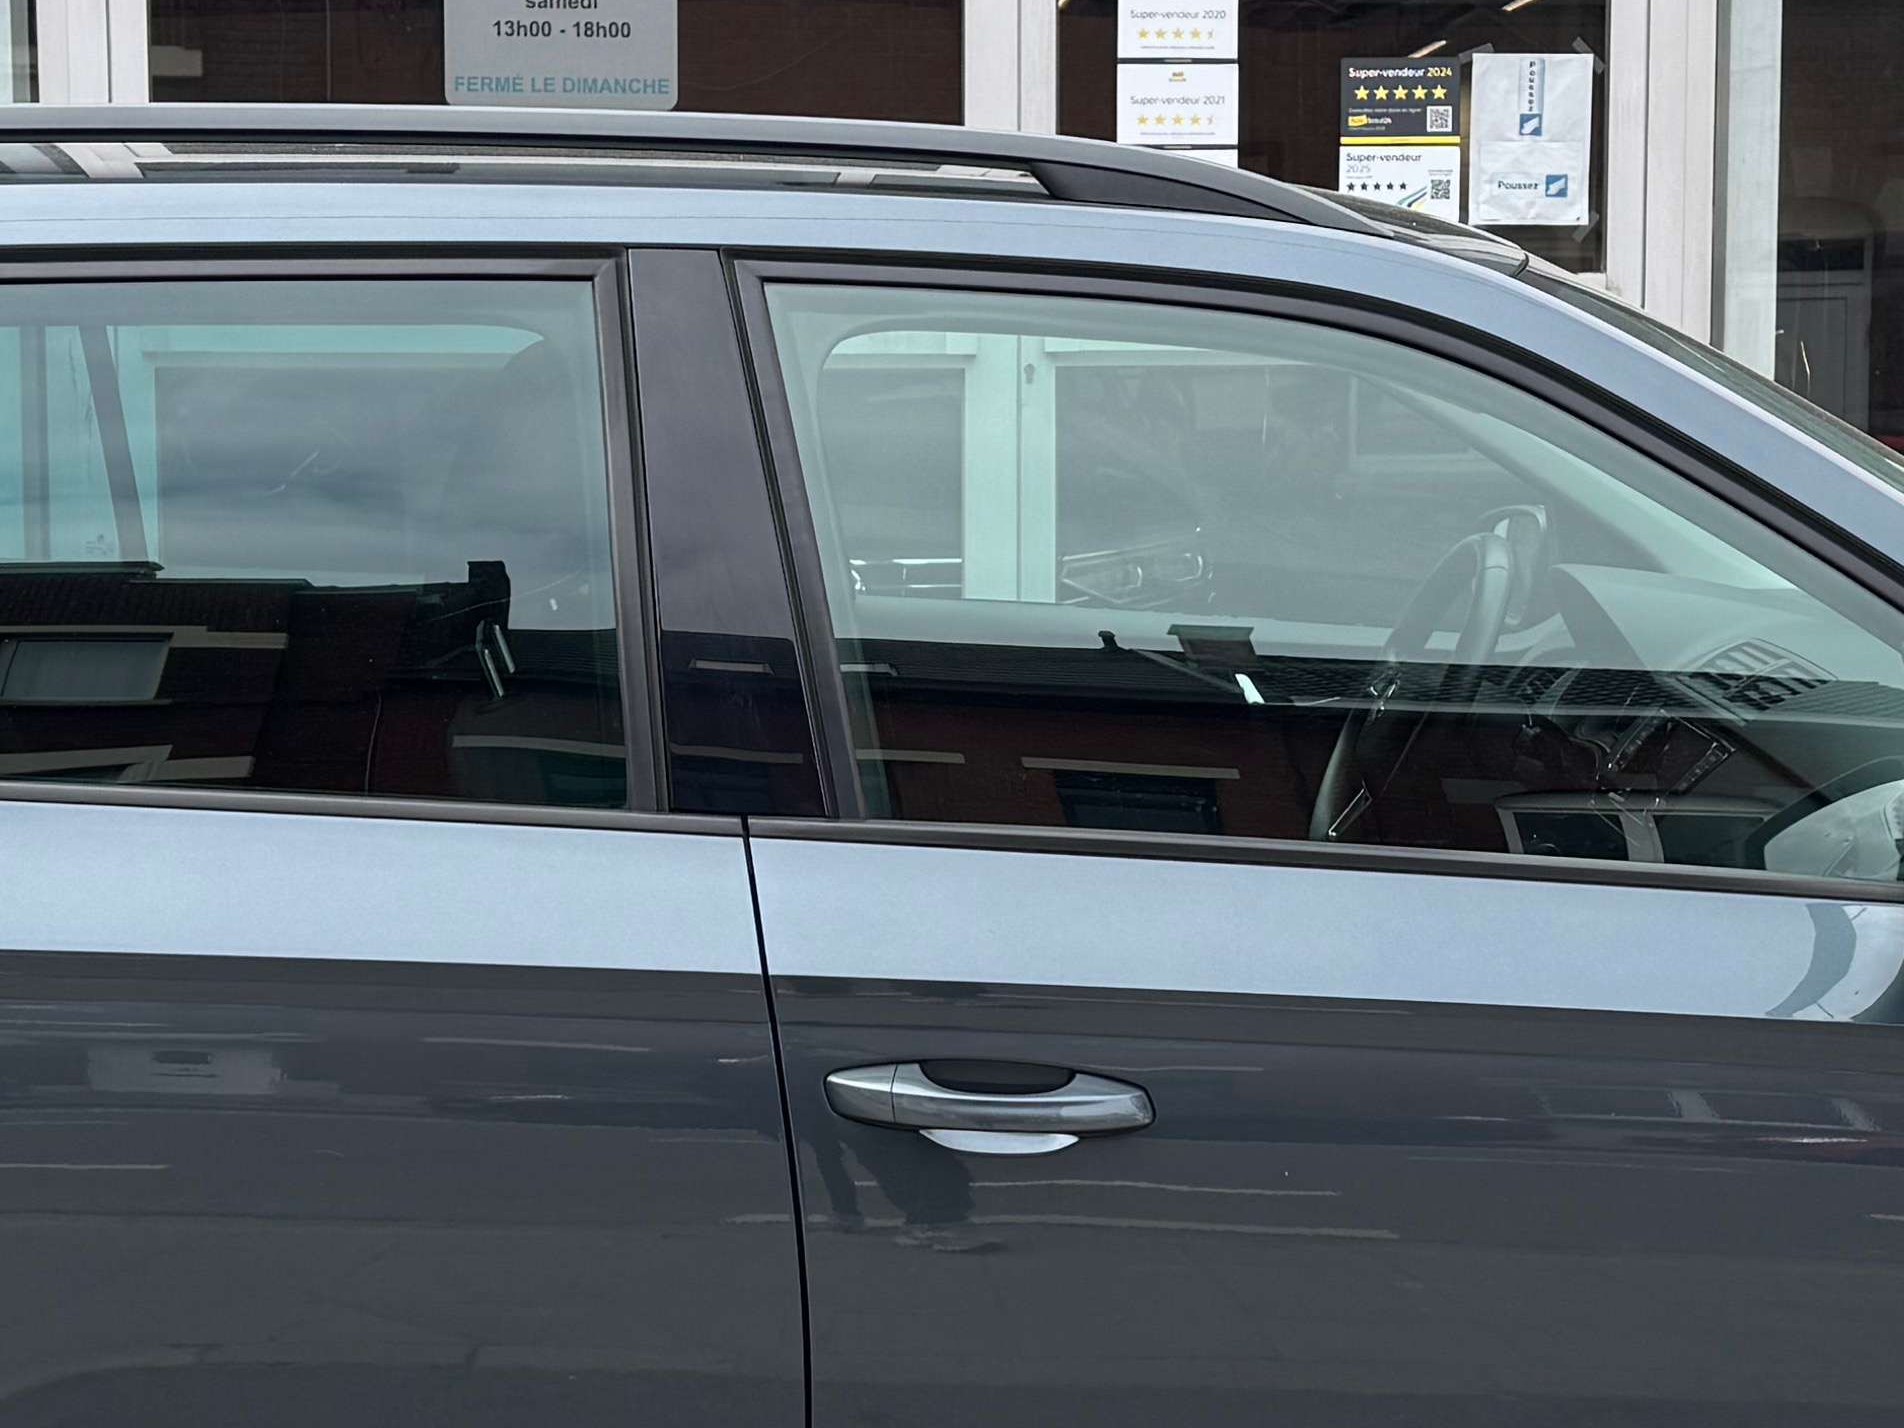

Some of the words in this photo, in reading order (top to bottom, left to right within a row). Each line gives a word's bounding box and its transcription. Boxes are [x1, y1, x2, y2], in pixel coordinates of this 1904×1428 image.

[493, 20, 551, 38] 13h00
[572, 21, 632, 38] 18h00
[1348, 66, 1425, 78] Super-vendeur
[1427, 66, 1453, 77] 2024
[453, 73, 524, 93] FERMÉ
[531, 76, 555, 93] LE
[562, 77, 670, 95] DIMANCHE
[1346, 152, 1422, 163] Super-vendeur
